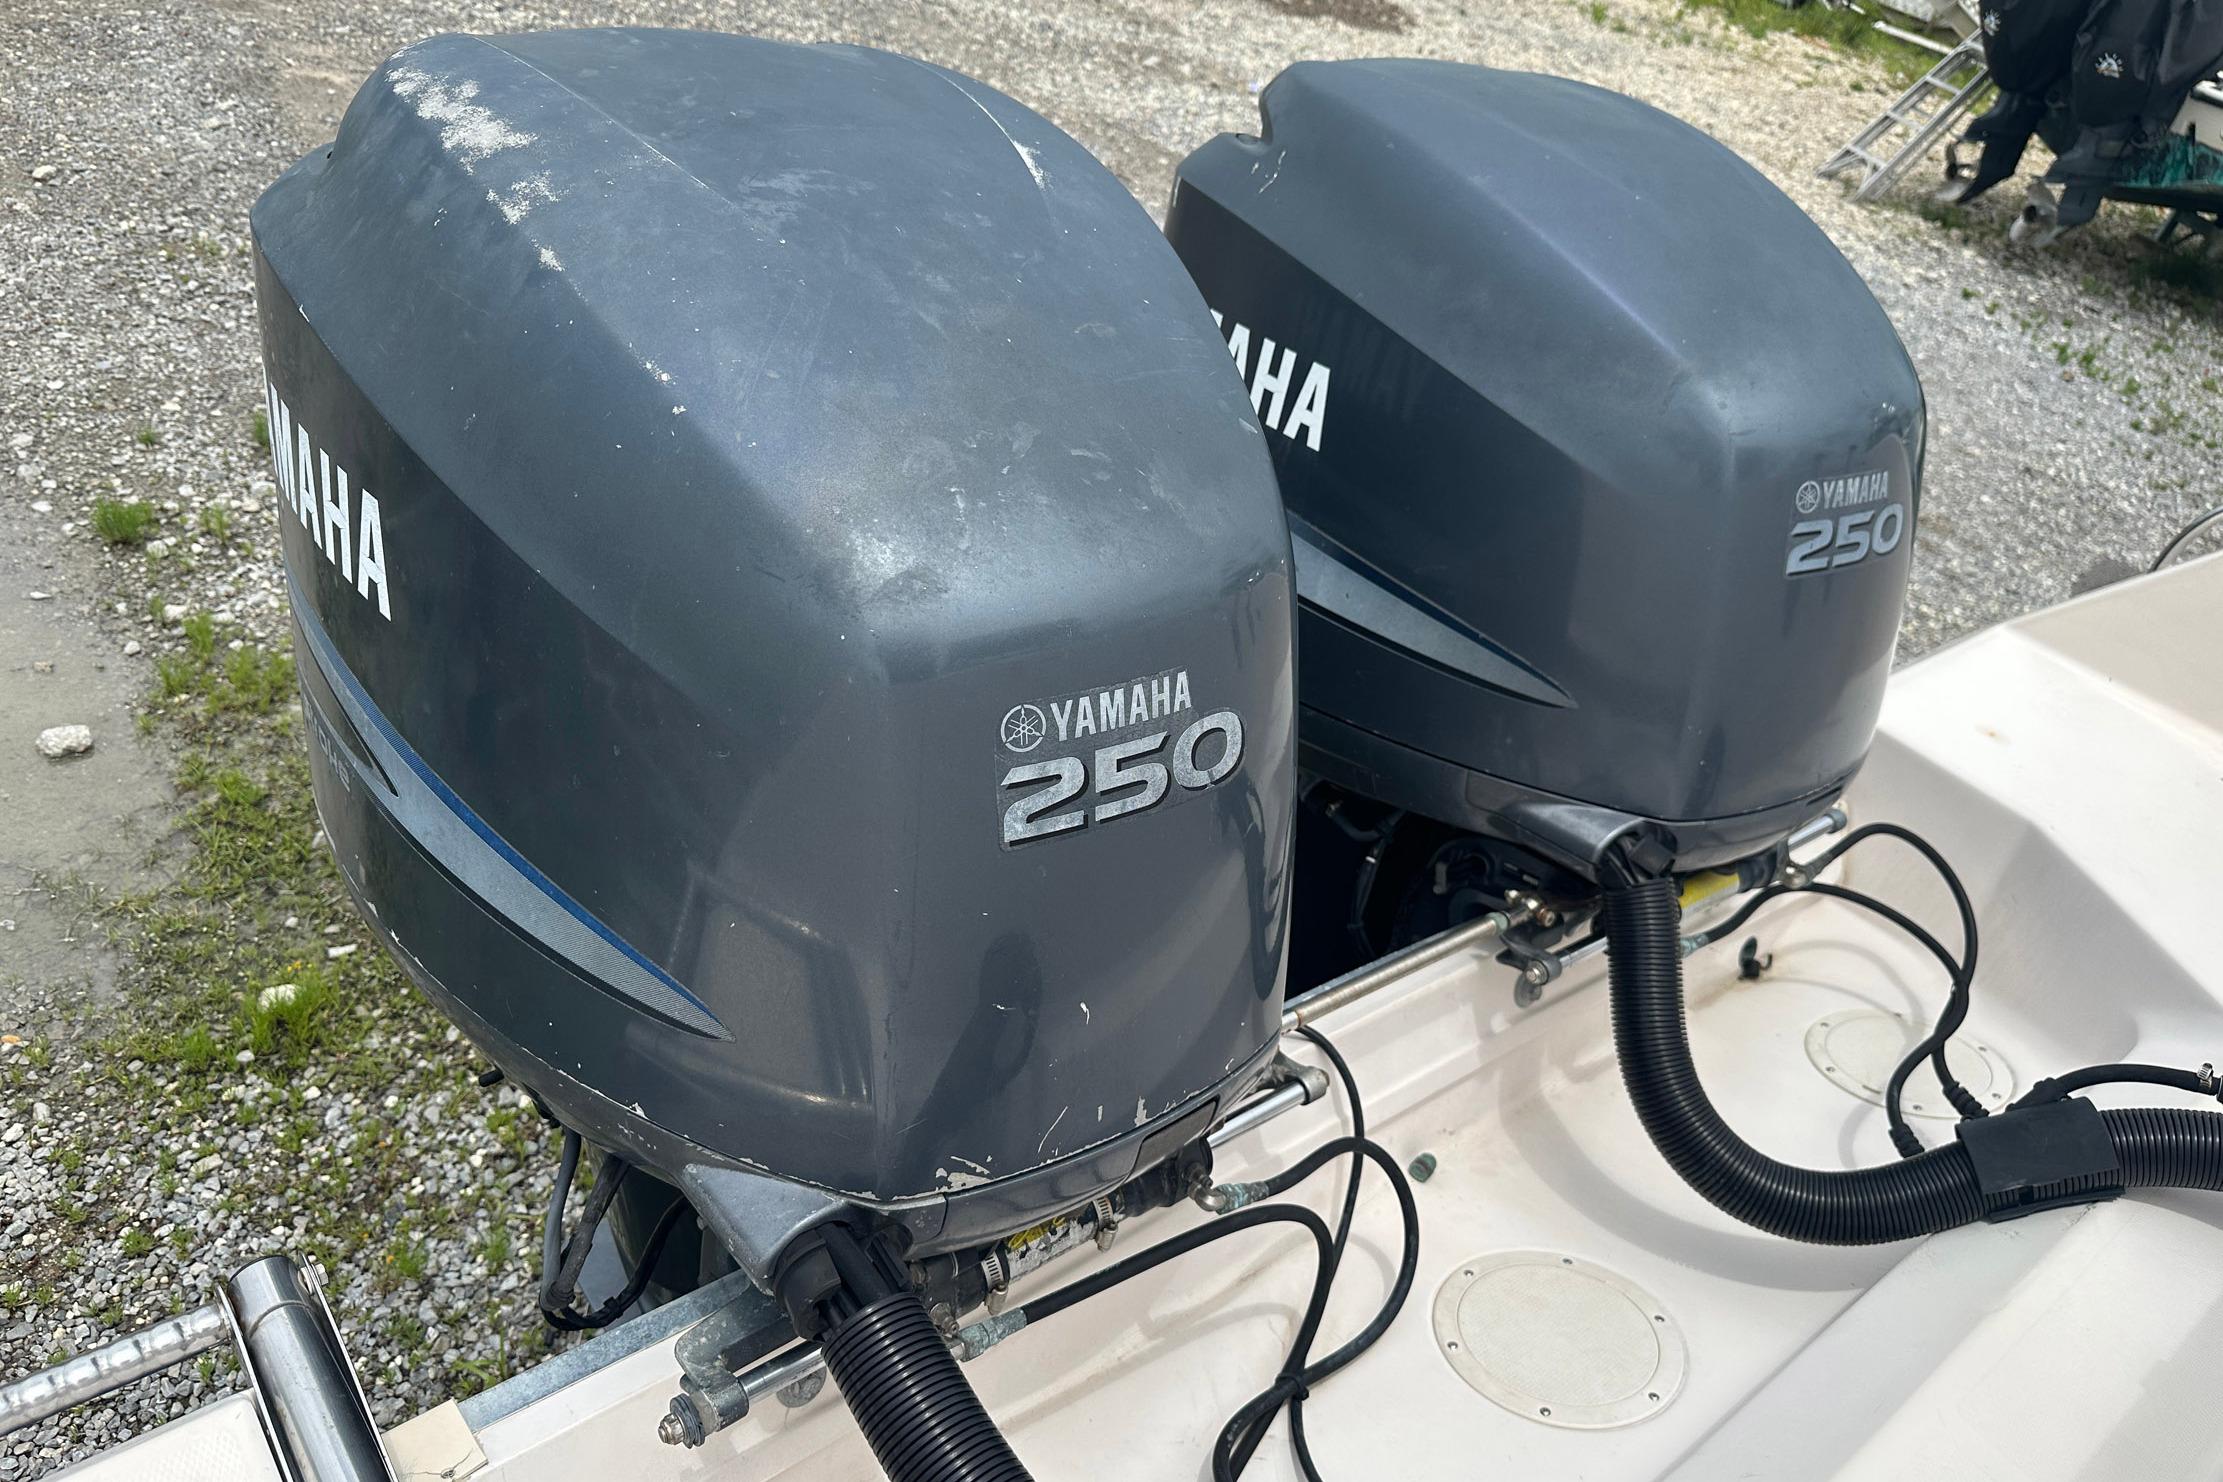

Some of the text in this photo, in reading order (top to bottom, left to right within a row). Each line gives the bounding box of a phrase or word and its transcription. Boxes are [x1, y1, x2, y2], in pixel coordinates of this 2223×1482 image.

[264, 368, 392, 621] MAHA
[1823, 471, 1889, 509] YAMAHA
[1786, 503, 1904, 576] 250
[1050, 670, 1192, 742] YAMAHA
[1000, 711, 1245, 846] 250
